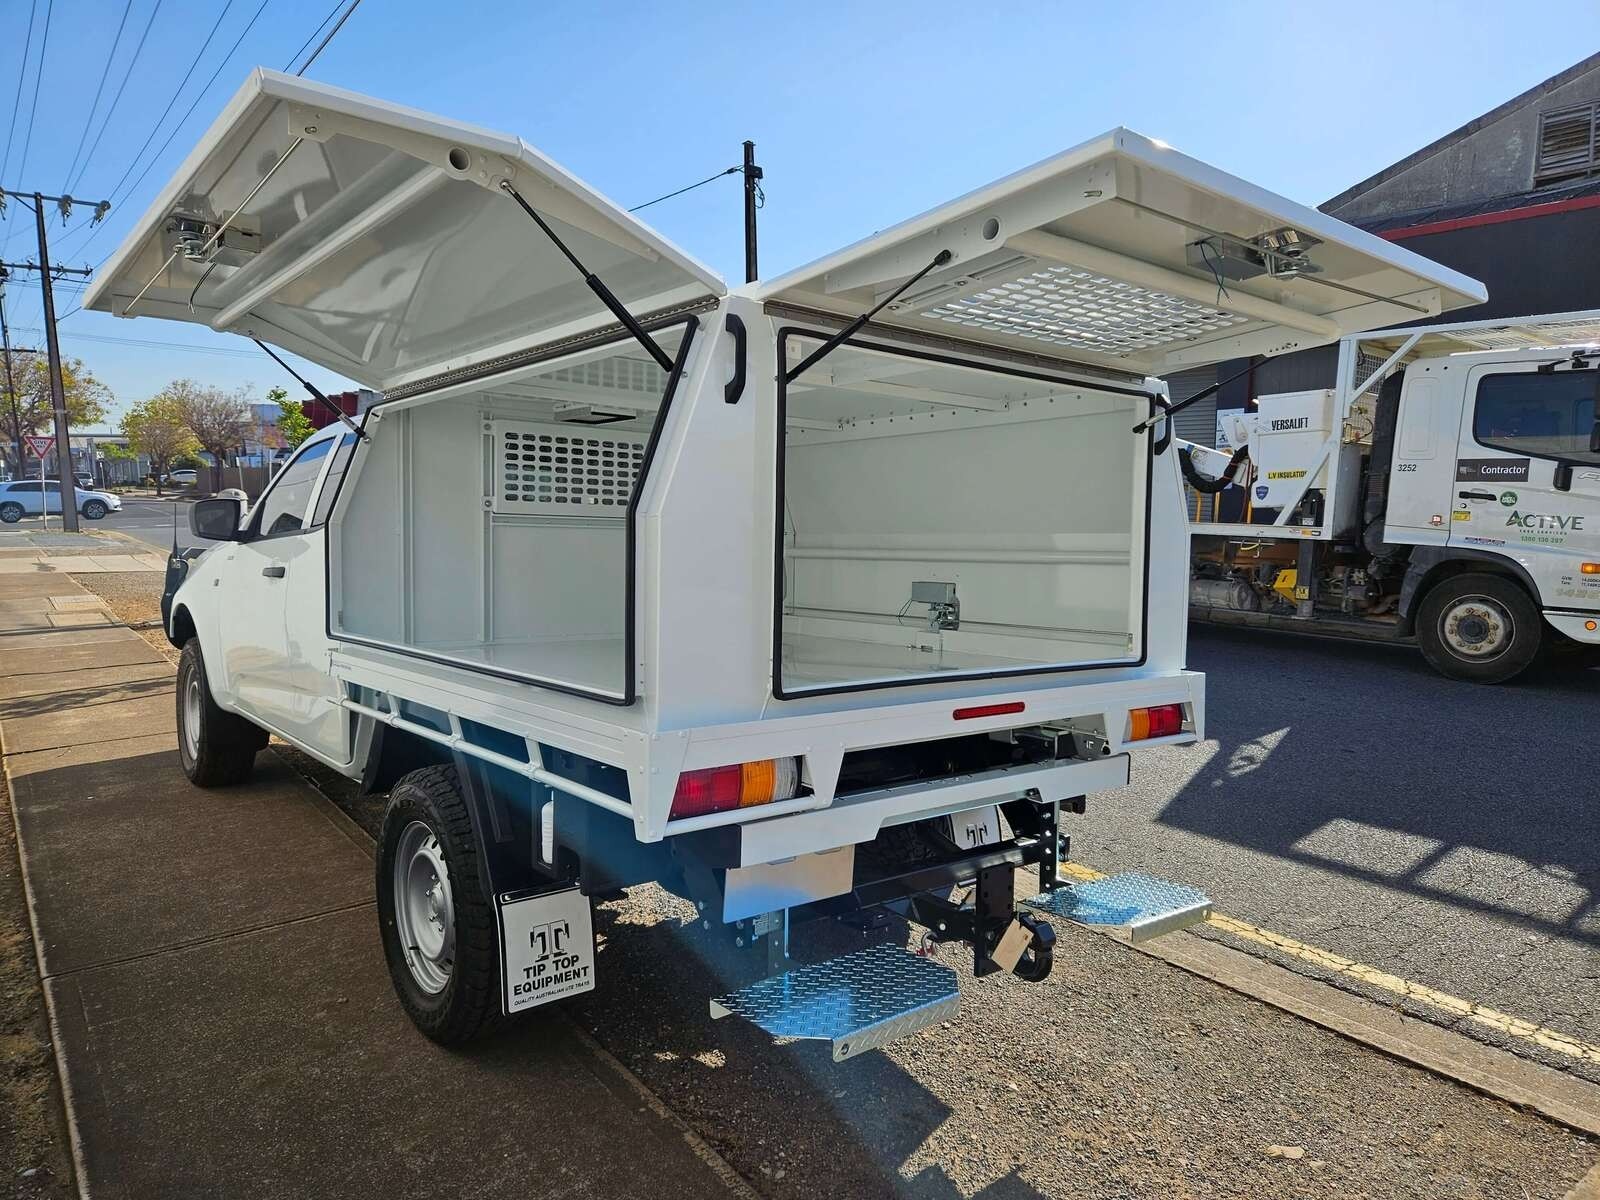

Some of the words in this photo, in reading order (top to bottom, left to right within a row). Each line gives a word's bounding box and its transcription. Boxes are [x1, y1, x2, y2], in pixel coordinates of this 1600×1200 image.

[1271, 417, 1309, 431] VERSALIFT
[1277, 470, 1307, 479] INSULATIO
[1398, 464, 1417, 472] 3252
[1481, 465, 1527, 475] Contractor
[1505, 510, 1585, 530] ACTIVE
[523, 963, 546, 979] TIP
[552, 955, 580, 971] TOP
[513, 966, 590, 996] EQUIPMENT
